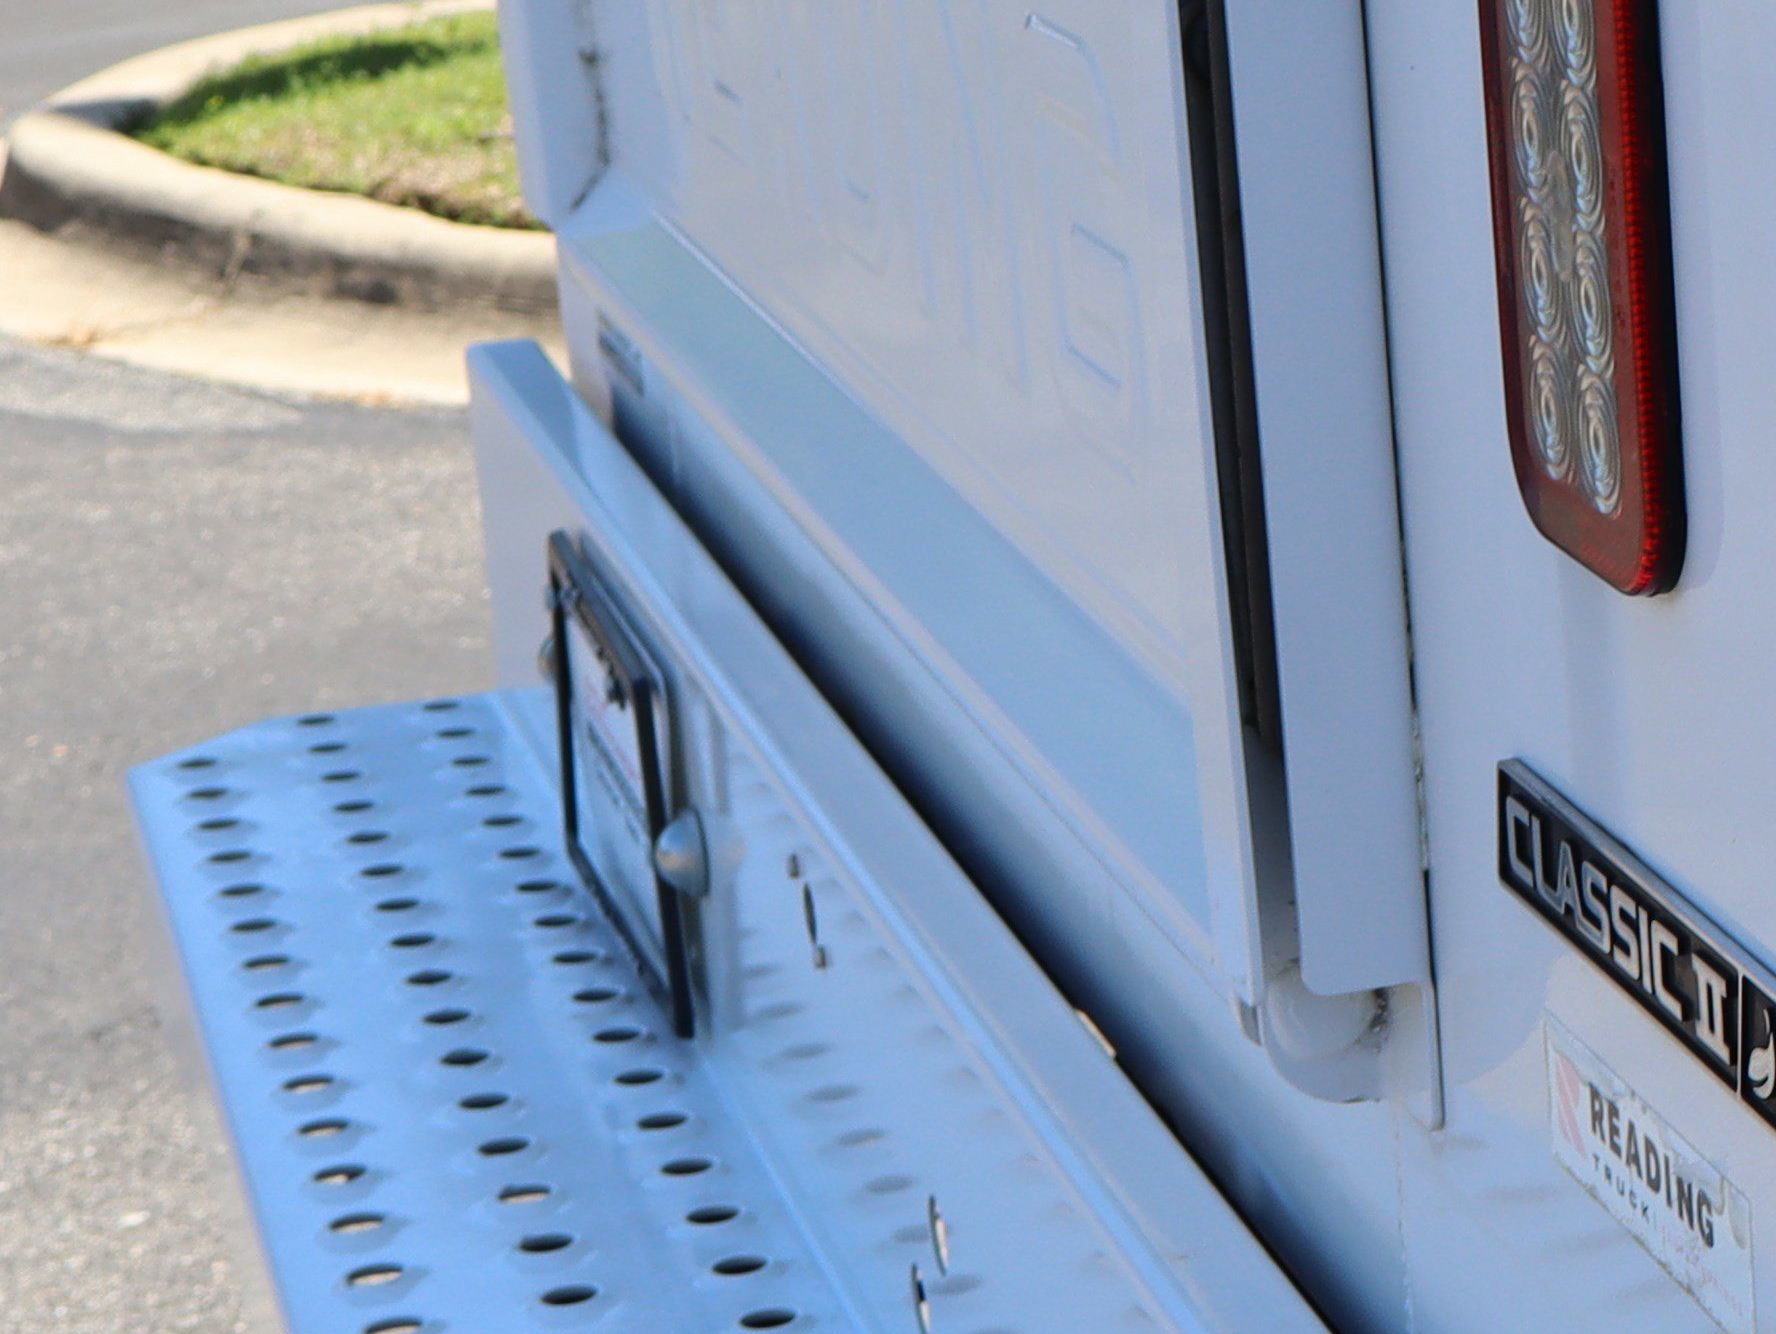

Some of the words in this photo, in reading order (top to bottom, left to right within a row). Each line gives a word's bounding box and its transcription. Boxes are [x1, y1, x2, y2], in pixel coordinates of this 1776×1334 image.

[1505, 794, 1684, 1023] CLASSIC
[1691, 950, 1734, 1066] II
[1588, 1080, 1716, 1250] READING
